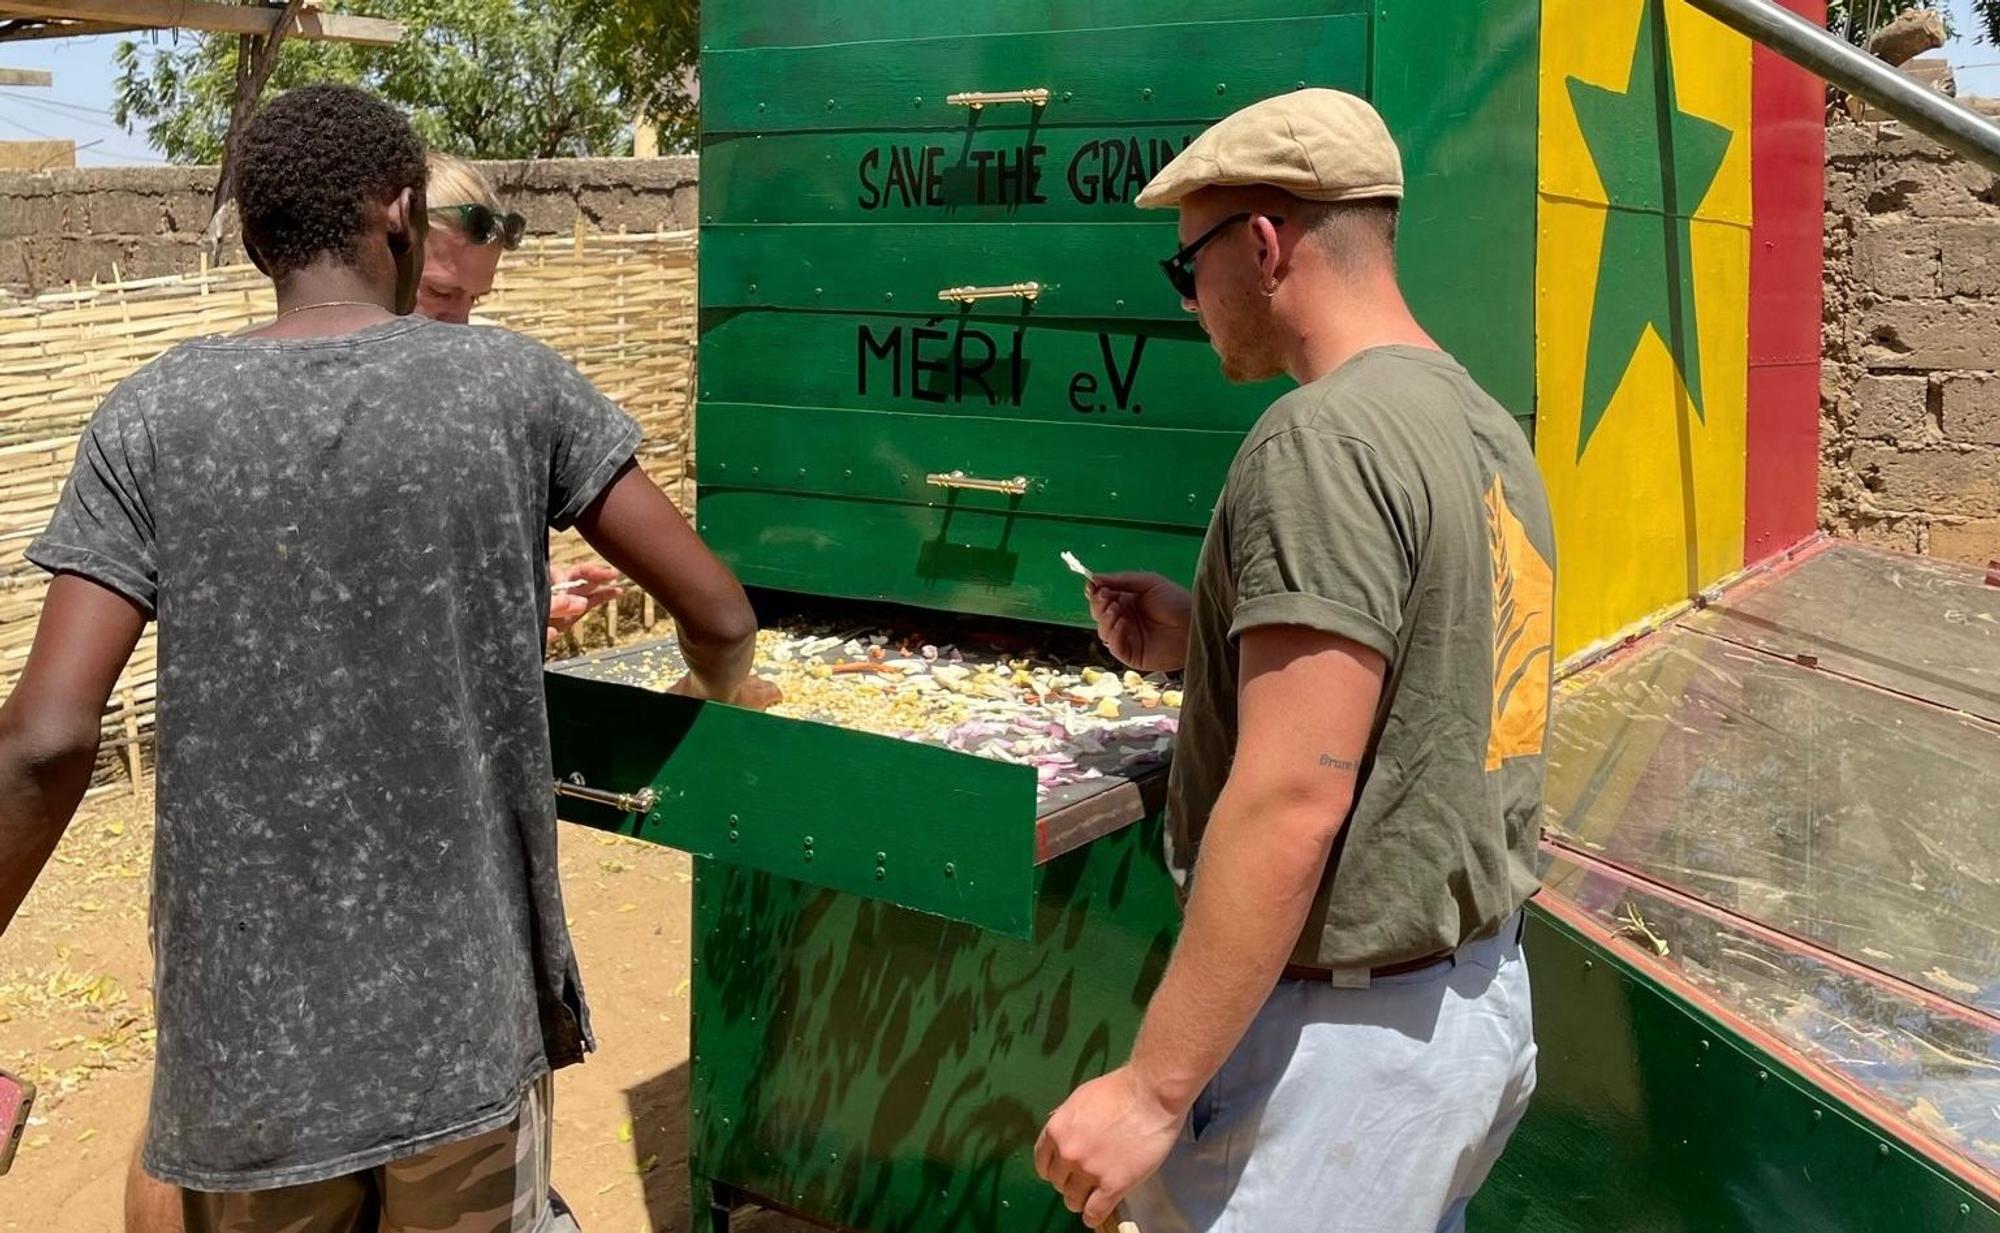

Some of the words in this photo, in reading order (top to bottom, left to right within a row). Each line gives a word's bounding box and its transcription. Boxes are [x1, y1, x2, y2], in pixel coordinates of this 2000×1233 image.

[858, 145, 944, 209] SAVE
[969, 146, 1046, 205] THE
[858, 318, 1022, 407] MÉRI
[1069, 332, 1147, 414] e.V.
